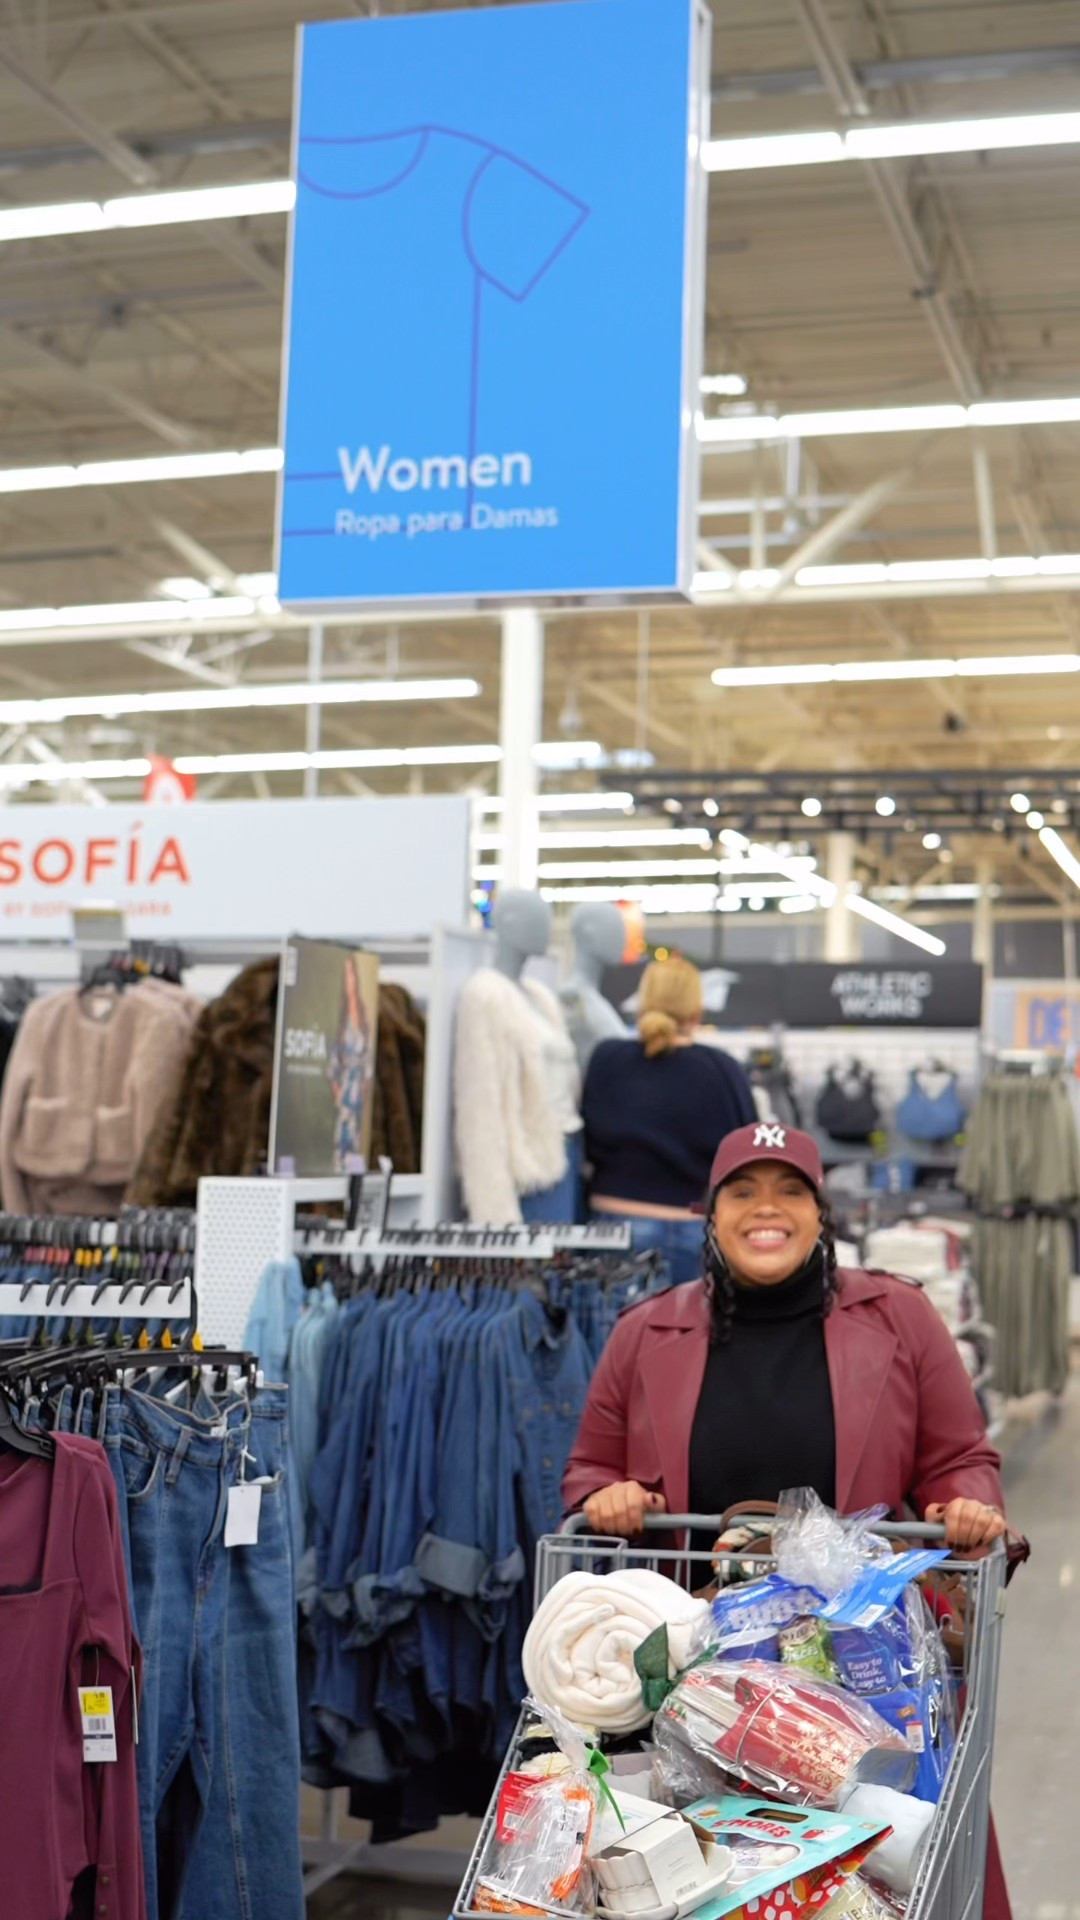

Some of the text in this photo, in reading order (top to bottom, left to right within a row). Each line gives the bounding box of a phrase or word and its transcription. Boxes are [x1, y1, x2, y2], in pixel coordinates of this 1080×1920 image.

[338, 444, 533, 494] Women
[335, 502, 559, 541] Ropa para Damas
[0, 820, 190, 886] SOFÍA
[753, 1124, 786, 1148] NY
[847, 1661, 870, 1672] Easy
